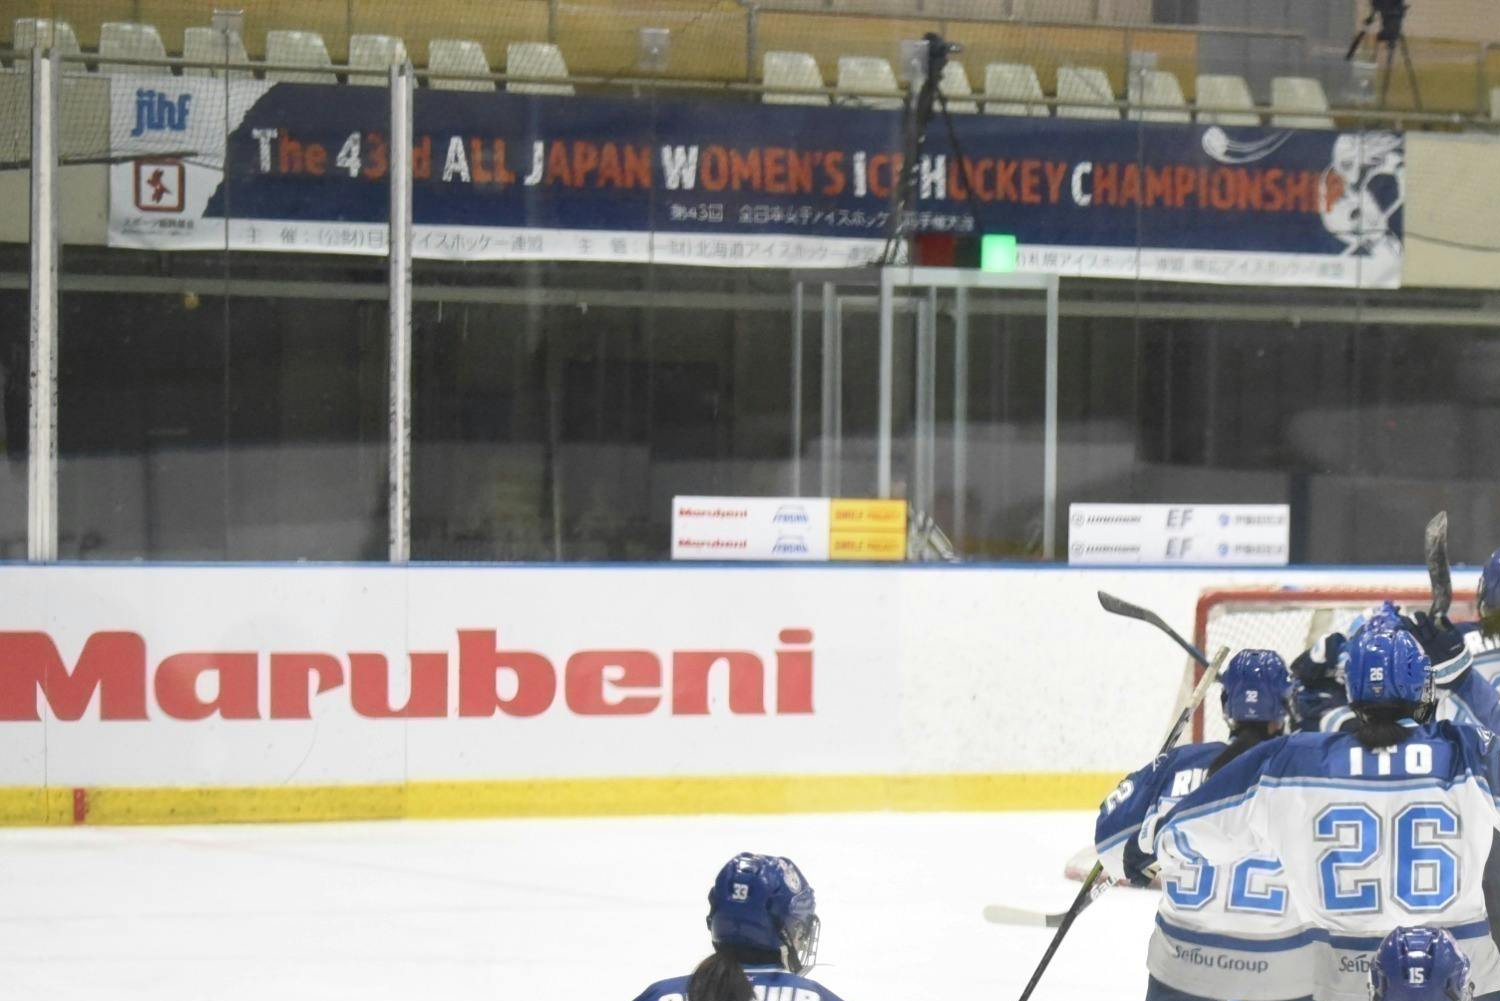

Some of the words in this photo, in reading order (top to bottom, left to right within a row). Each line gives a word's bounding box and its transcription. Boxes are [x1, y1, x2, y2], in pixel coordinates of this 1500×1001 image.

[251, 127, 328, 176] The
[336, 131, 432, 181] 43d
[441, 135, 517, 184] ALL
[523, 139, 652, 189] JAPAN
[660, 144, 847, 196] WOMEN'S
[919, 152, 1068, 206] HOCKEY
[1070, 160, 1345, 215] CHAMPIONSHIP
[0, 627, 816, 722] Marubeni
[1348, 743, 1433, 775] ITO
[1312, 801, 1463, 915] 26
[1172, 945, 1215, 969] Seibu
[1217, 953, 1269, 974] Group
[1337, 953, 1373, 973] Seib
[1408, 966, 1425, 984] 15
